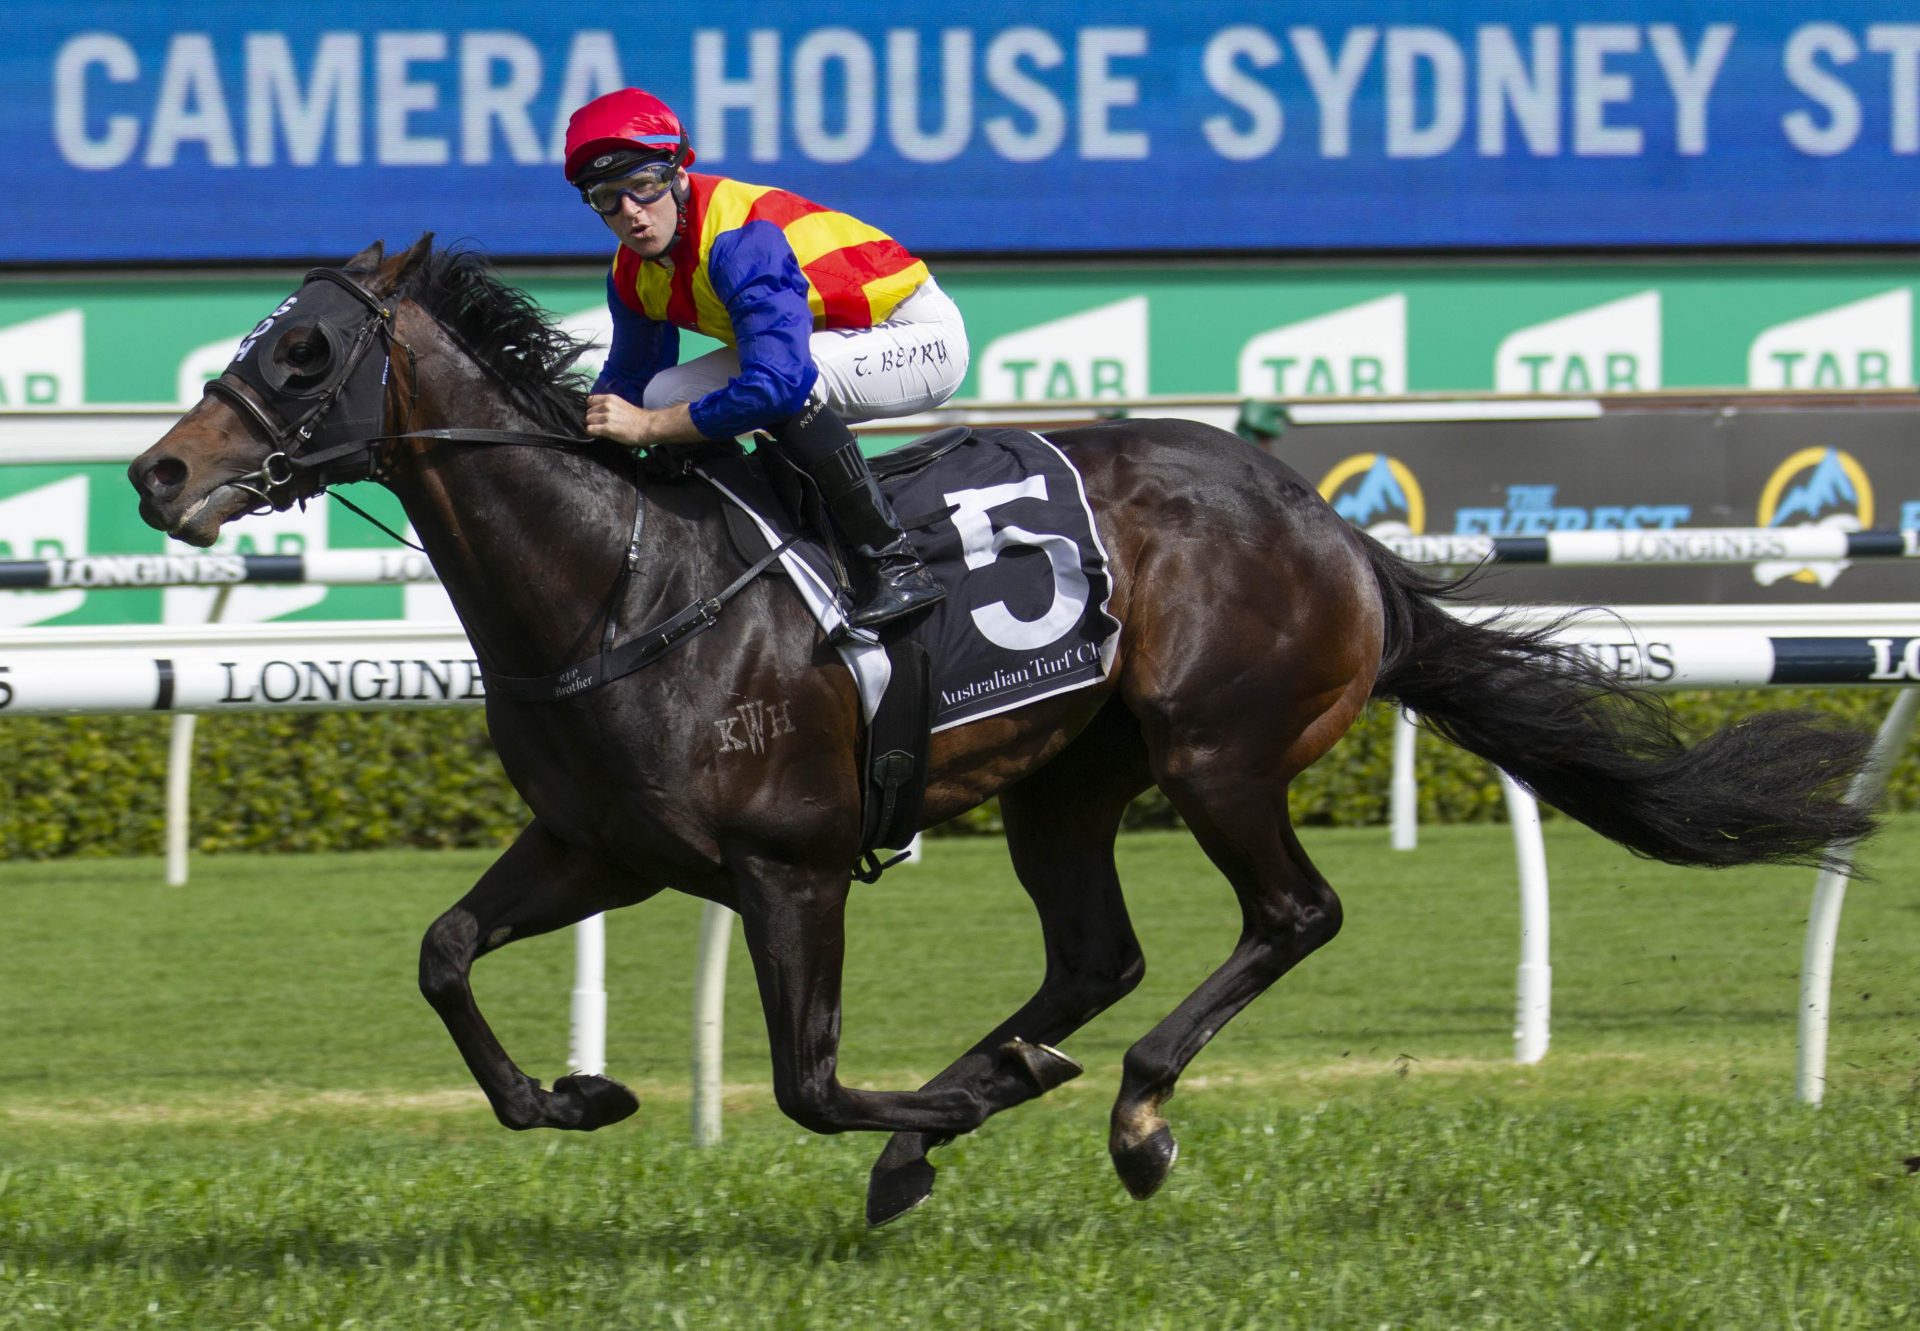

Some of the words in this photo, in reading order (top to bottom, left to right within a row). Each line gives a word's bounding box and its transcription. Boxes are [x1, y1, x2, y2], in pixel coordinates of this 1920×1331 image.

[54, 31, 624, 170] CAMERA
[692, 27, 1150, 163] HOUSE
[1202, 24, 1736, 160] SYDNEY
[1782, 22, 1920, 156] ST
[48, 555, 248, 588] LONGINES
[943, 474, 1090, 651] 5
[1615, 531, 1787, 560] LONGINES
[939, 666, 1031, 706] Australian
[1029, 649, 1072, 677] Turf
